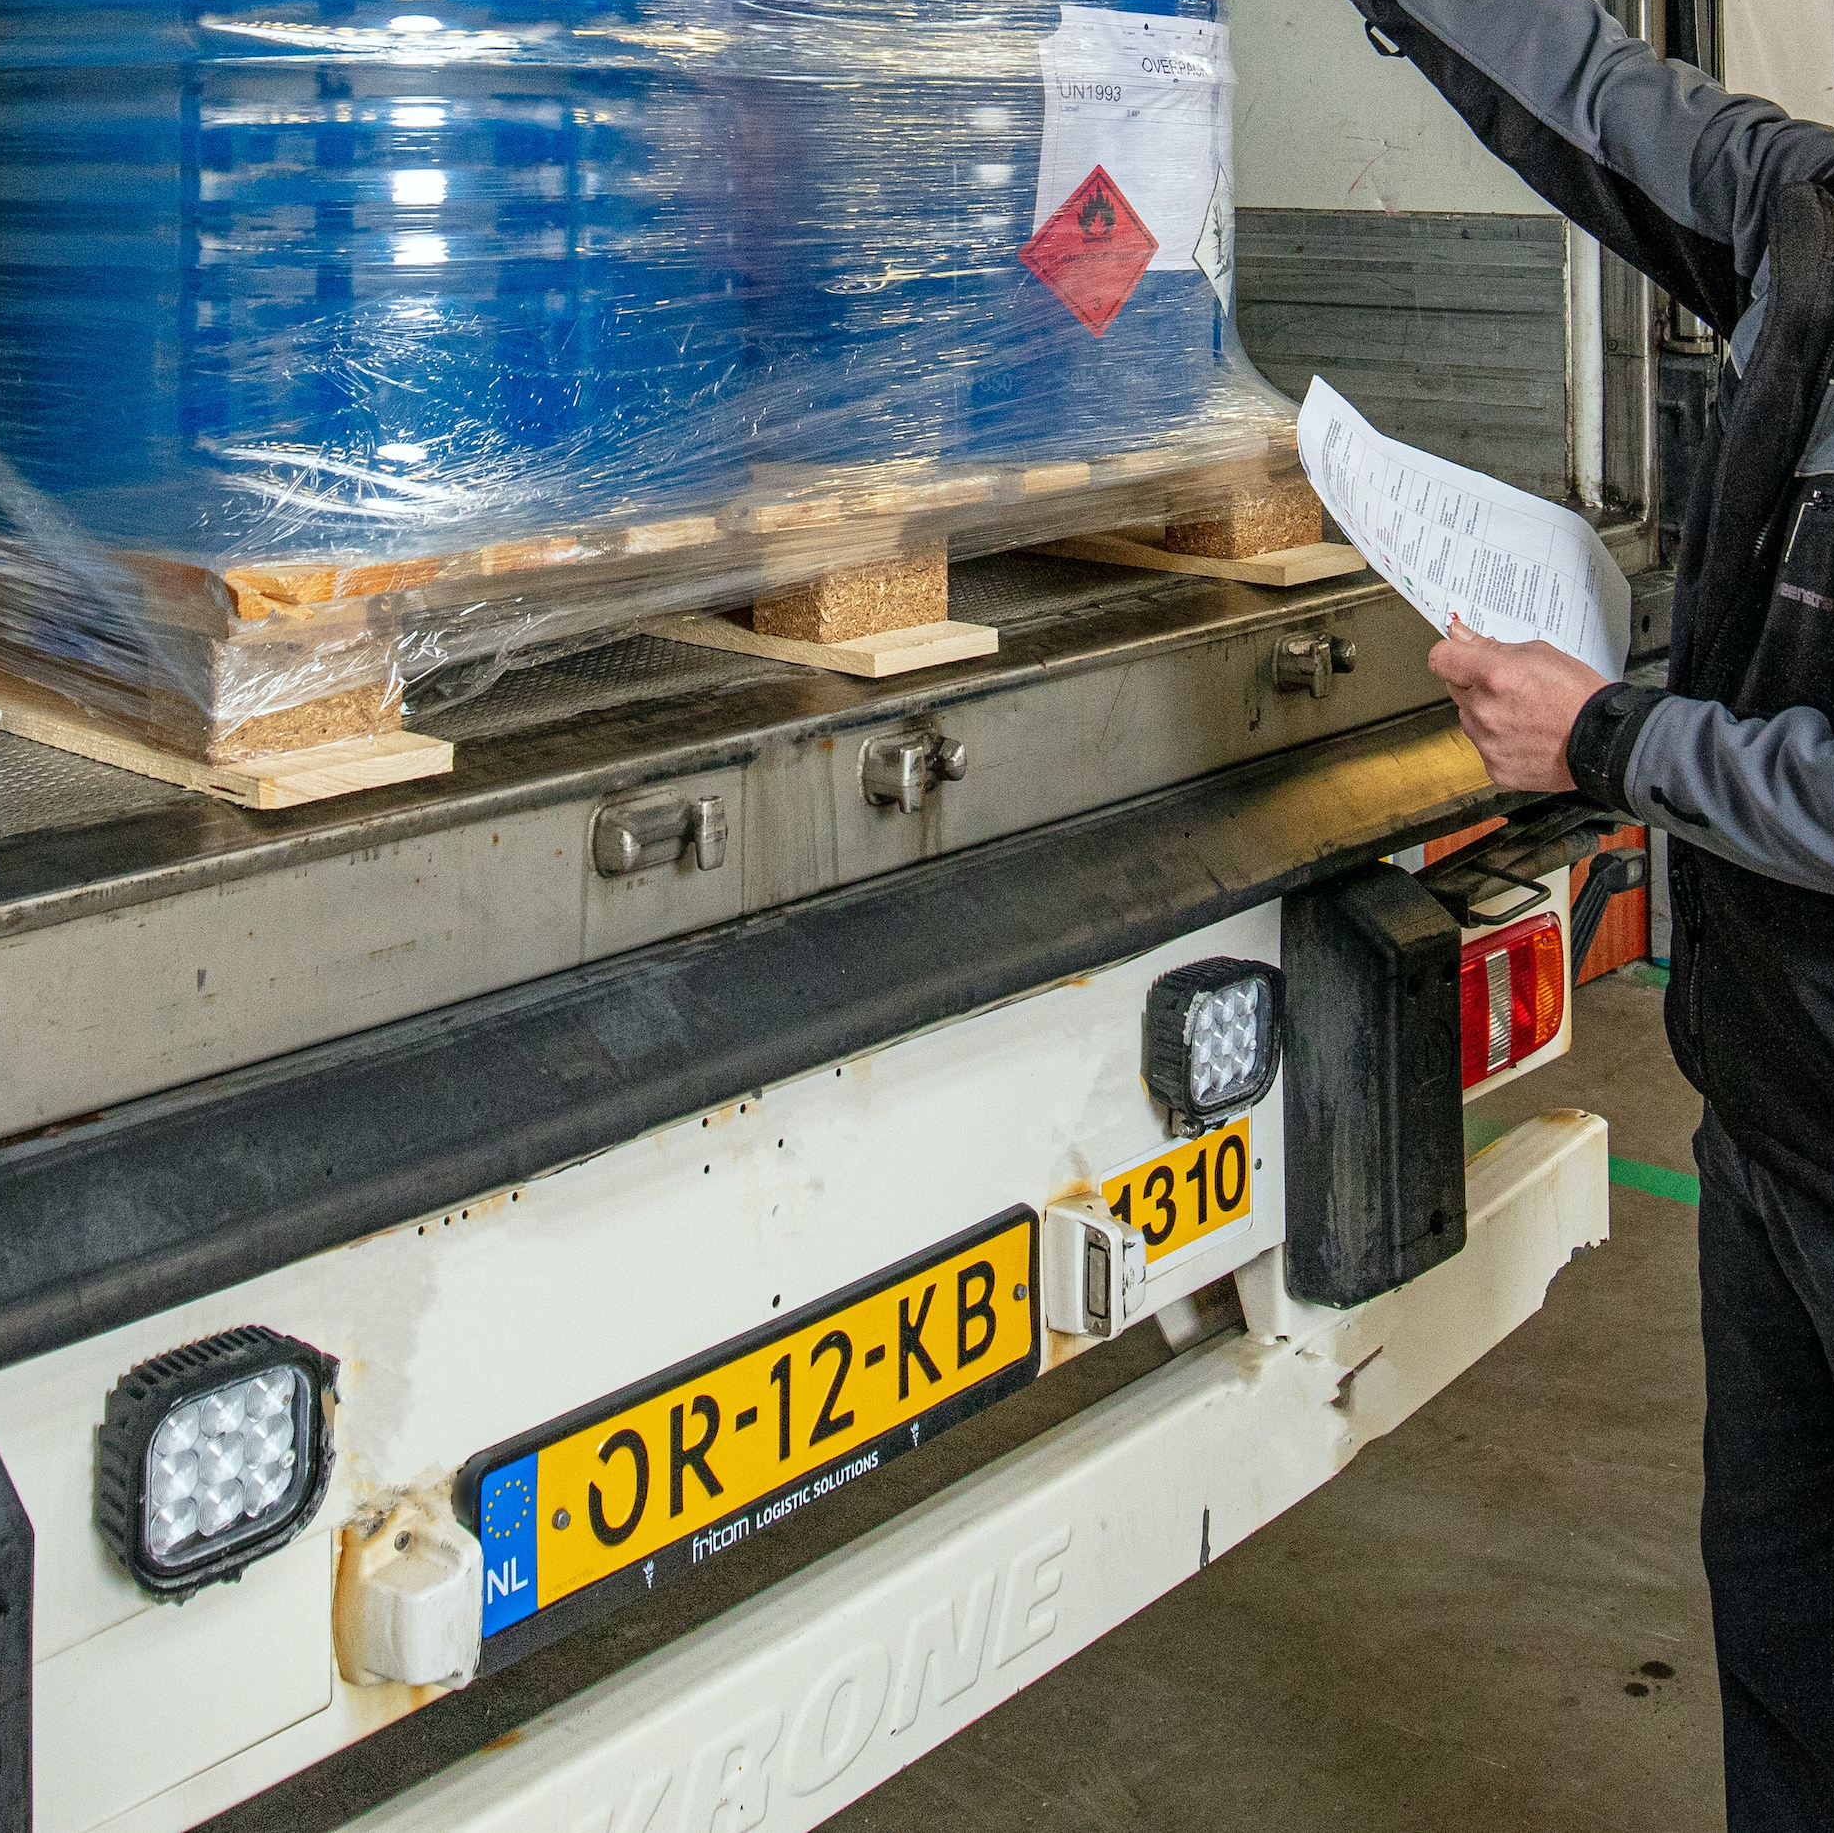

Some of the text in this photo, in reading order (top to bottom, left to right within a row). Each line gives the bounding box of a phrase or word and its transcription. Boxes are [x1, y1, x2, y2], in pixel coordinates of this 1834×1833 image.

[1060, 82, 1122, 102] UN1993
[1092, 297, 1102, 311] 3
[1109, 1134, 1246, 1247] 1310
[587, 1259, 998, 1547] OR-12-KB
[692, 1450, 879, 1564] fritom LOGISTIC SOLUTIONS
[487, 1555, 529, 1606] NL
